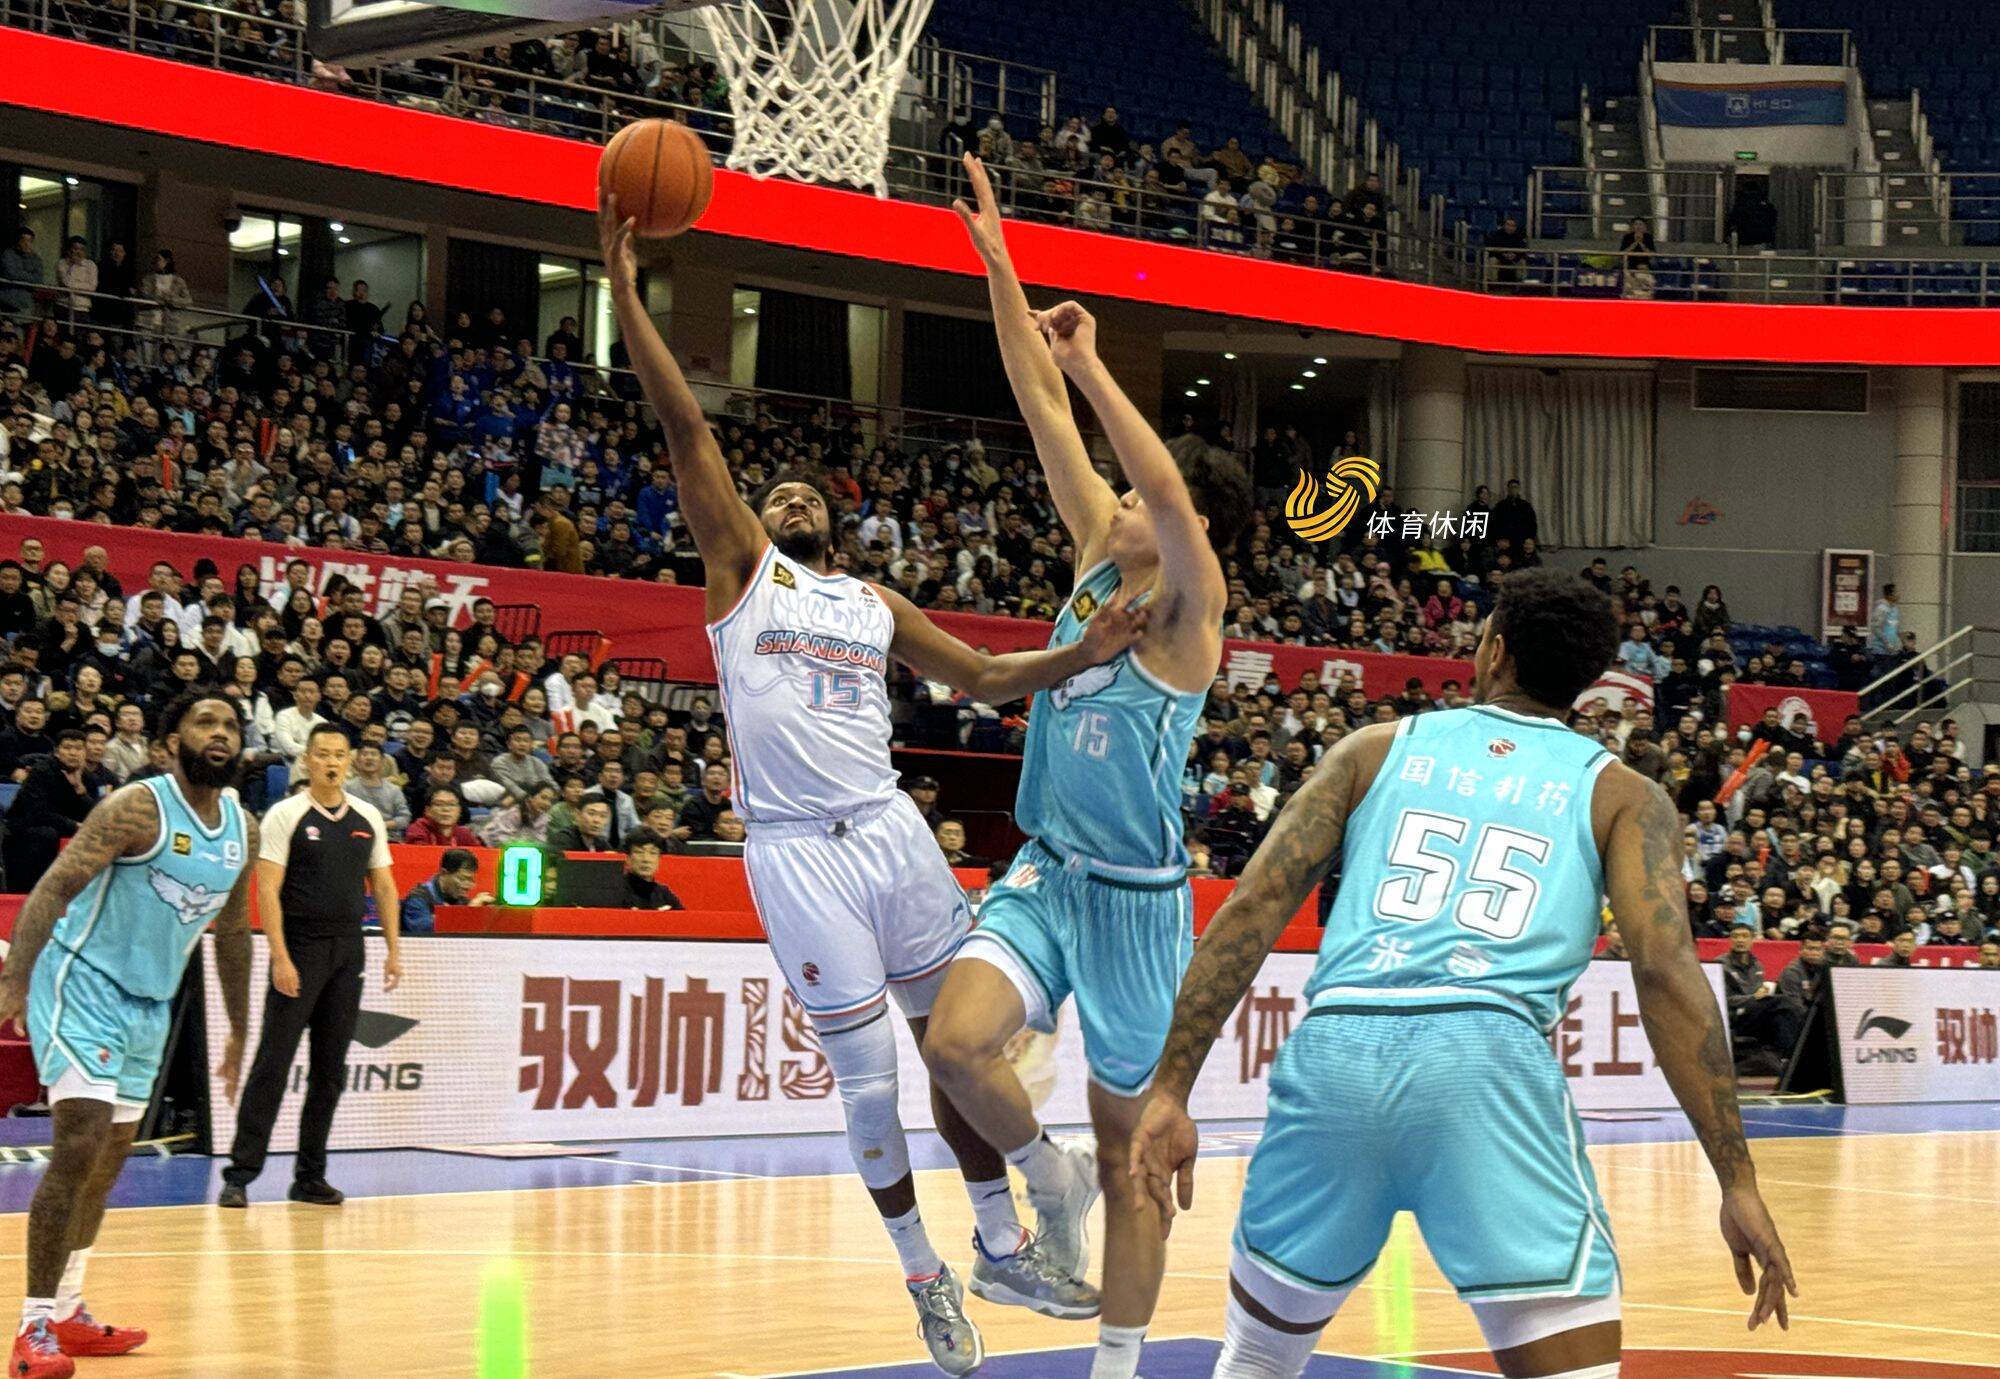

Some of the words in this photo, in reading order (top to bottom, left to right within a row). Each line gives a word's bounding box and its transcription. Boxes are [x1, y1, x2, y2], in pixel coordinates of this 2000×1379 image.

[755, 630, 886, 677] SHANDONG
[808, 671, 862, 711] 15
[1073, 710, 1108, 758] 15
[503, 846, 542, 906] 0
[1373, 808, 1553, 943] 55
